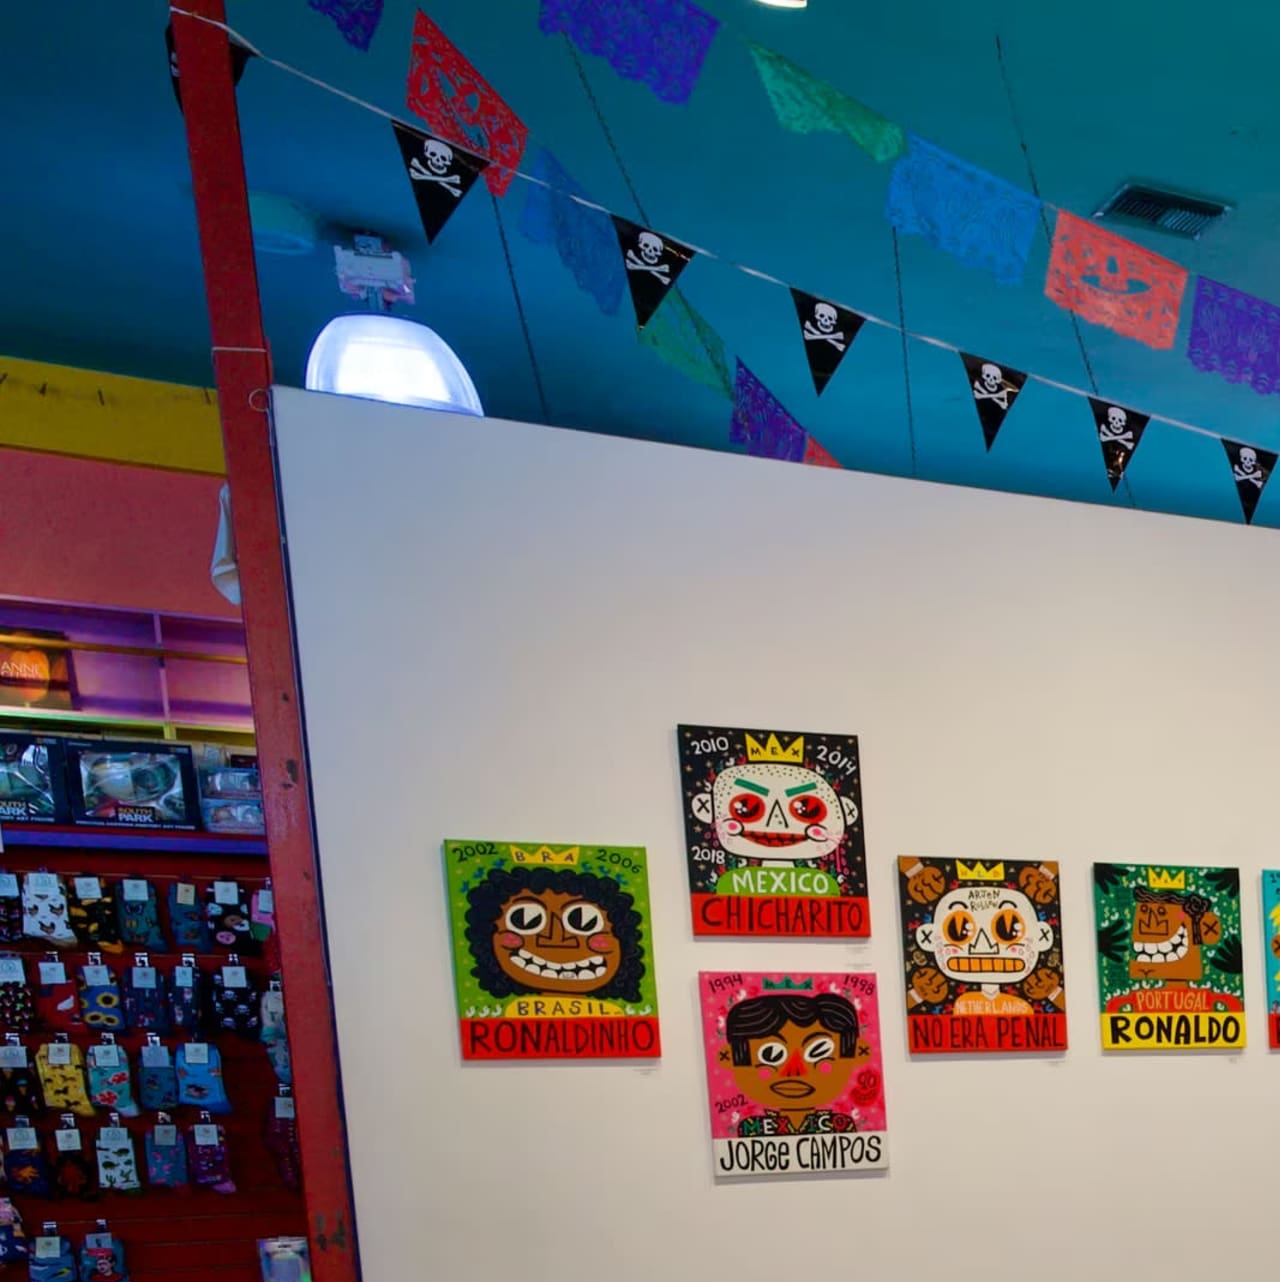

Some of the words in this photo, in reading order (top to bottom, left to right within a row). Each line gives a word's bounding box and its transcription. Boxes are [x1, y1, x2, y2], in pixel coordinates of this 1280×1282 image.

[691, 737, 729, 755] 2010
[816, 746, 857, 775] 2014
[452, 842, 498, 862] 2002
[597, 849, 643, 874] 2006
[691, 846, 726, 864] 2018
[732, 870, 829, 894] MEXICO
[701, 896, 863, 932] CHICHARITO
[708, 974, 743, 993] 1994
[843, 974, 876, 996] 1998
[1136, 991, 1210, 1011] PORTUGAL
[469, 1020, 655, 1054] RONALDINHO
[912, 1018, 943, 1048] NO
[951, 1018, 986, 1048] ERA
[997, 1017, 1064, 1047] PENAL
[1110, 1015, 1240, 1045] RONALDO
[715, 1095, 748, 1113] 2002
[796, 1136, 882, 1169] CAMPOS
